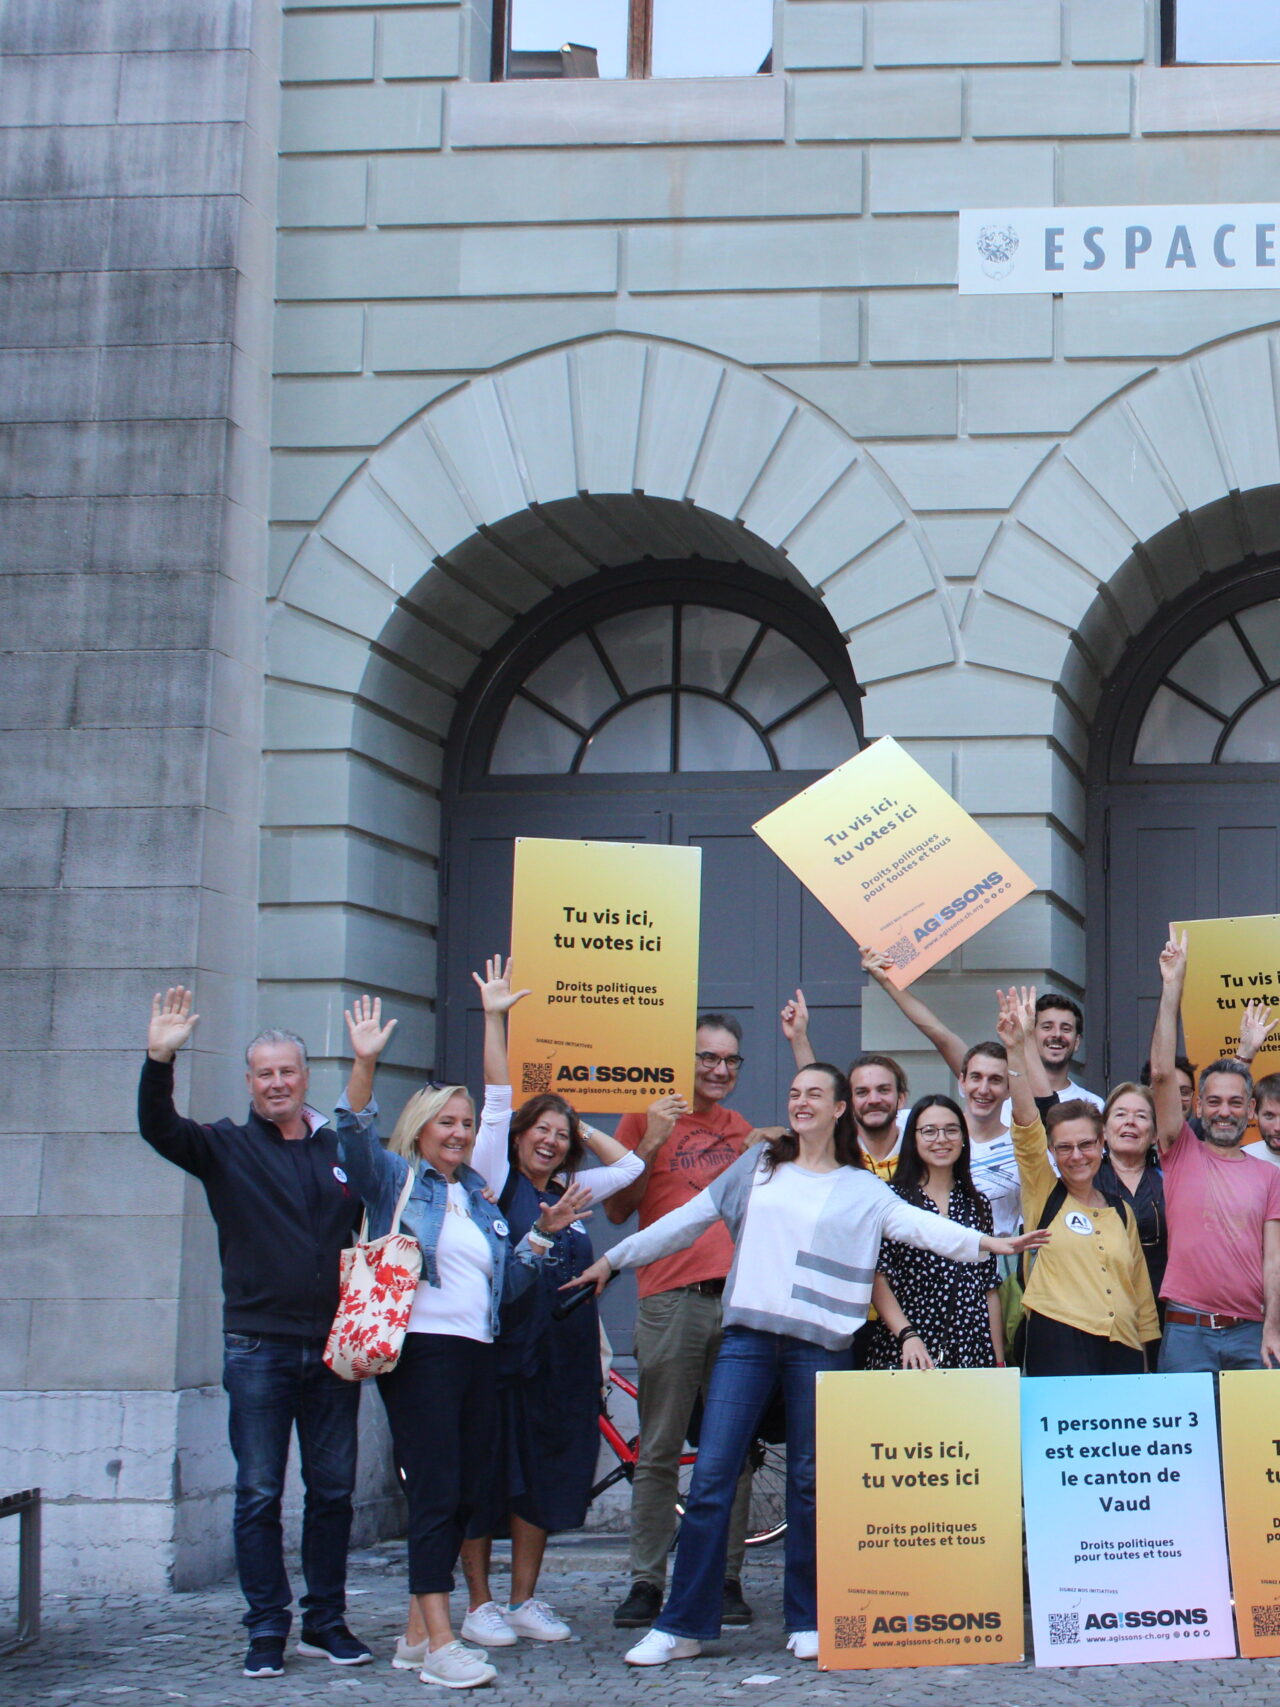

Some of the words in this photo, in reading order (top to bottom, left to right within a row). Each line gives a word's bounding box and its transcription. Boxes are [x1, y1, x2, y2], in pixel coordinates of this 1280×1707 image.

[1044, 222, 1276, 271] ESPACE
[823, 829, 849, 847] Tu
[847, 813, 873, 832] vis
[869, 796, 898, 816] ici,
[833, 850, 855, 866] tu
[853, 820, 897, 852] votes
[894, 803, 918, 823] ici
[562, 906, 588, 924] Tu
[592, 908, 620, 925] vis
[625, 909, 654, 929] ici,
[553, 932, 575, 949] tu
[580, 934, 634, 951] votes
[639, 935, 662, 952] ici
[555, 979, 593, 992] Droits
[595, 981, 658, 996] politiques
[1220, 974, 1244, 988] Tu
[1247, 972, 1273, 986] vis
[547, 994, 578, 1005] pour
[579, 993, 620, 1005] toutes
[621, 995, 635, 1006] et
[637, 995, 665, 1007] tous
[1216, 997, 1236, 1009] tu
[1039, 1416, 1049, 1432] 1
[1057, 1416, 1148, 1436] personne
[1152, 1415, 1183, 1429] sur
[1187, 1411, 1199, 1428] 3
[869, 1442, 898, 1461] Tu
[903, 1441, 934, 1460] vis
[939, 1440, 970, 1461] ici,
[1044, 1443, 1075, 1460] est
[1078, 1441, 1142, 1459] exclue
[1146, 1439, 1193, 1456] dans
[861, 1472, 885, 1489] tu
[891, 1470, 950, 1488] votes
[955, 1467, 980, 1486] ici
[1060, 1470, 1079, 1487] le
[1083, 1469, 1152, 1486] canton
[1156, 1466, 1181, 1483] de
[1098, 1494, 1151, 1513] Vaud
[866, 1522, 907, 1536] Droits
[909, 1521, 978, 1536] politiques
[857, 1539, 890, 1552] pour
[892, 1535, 937, 1548] toutes
[939, 1534, 954, 1547] et
[956, 1534, 986, 1546] tous
[1079, 1539, 1115, 1551] Droits
[1116, 1537, 1175, 1551] politiques
[1073, 1553, 1102, 1564] pour
[1103, 1550, 1141, 1561] toutes
[1142, 1549, 1155, 1559] et
[1156, 1549, 1182, 1559] tous
